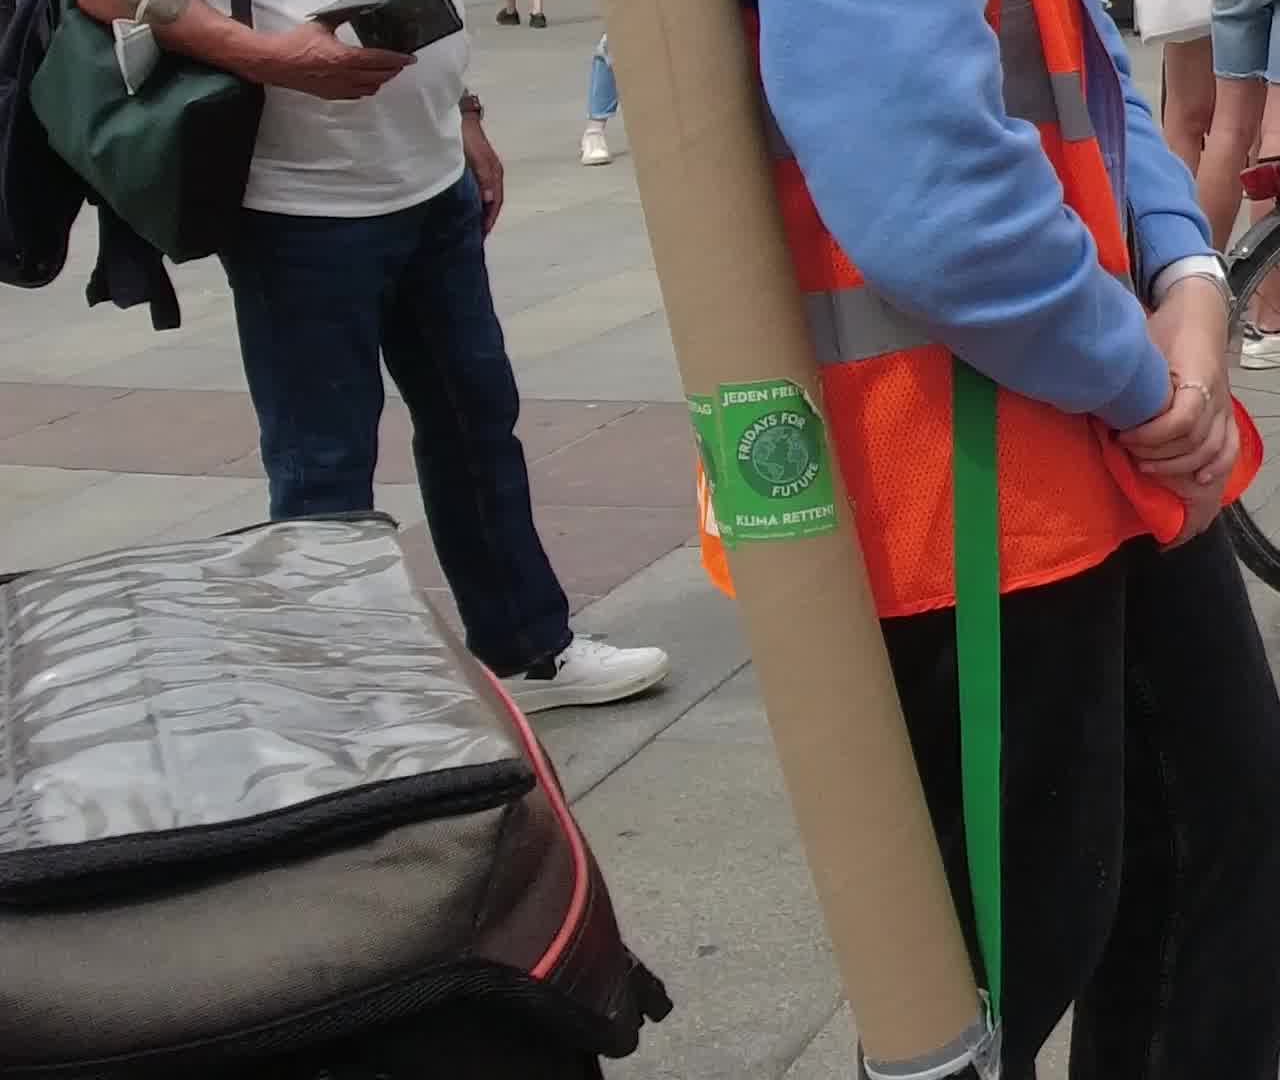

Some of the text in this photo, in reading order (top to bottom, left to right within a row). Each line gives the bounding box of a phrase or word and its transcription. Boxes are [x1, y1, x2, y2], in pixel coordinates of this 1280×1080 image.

[722, 389, 768, 406] JEDEN
[739, 413, 777, 460] FRIDAYS
[772, 463, 818, 497] FUTURE
[736, 513, 779, 527] KLIMA
